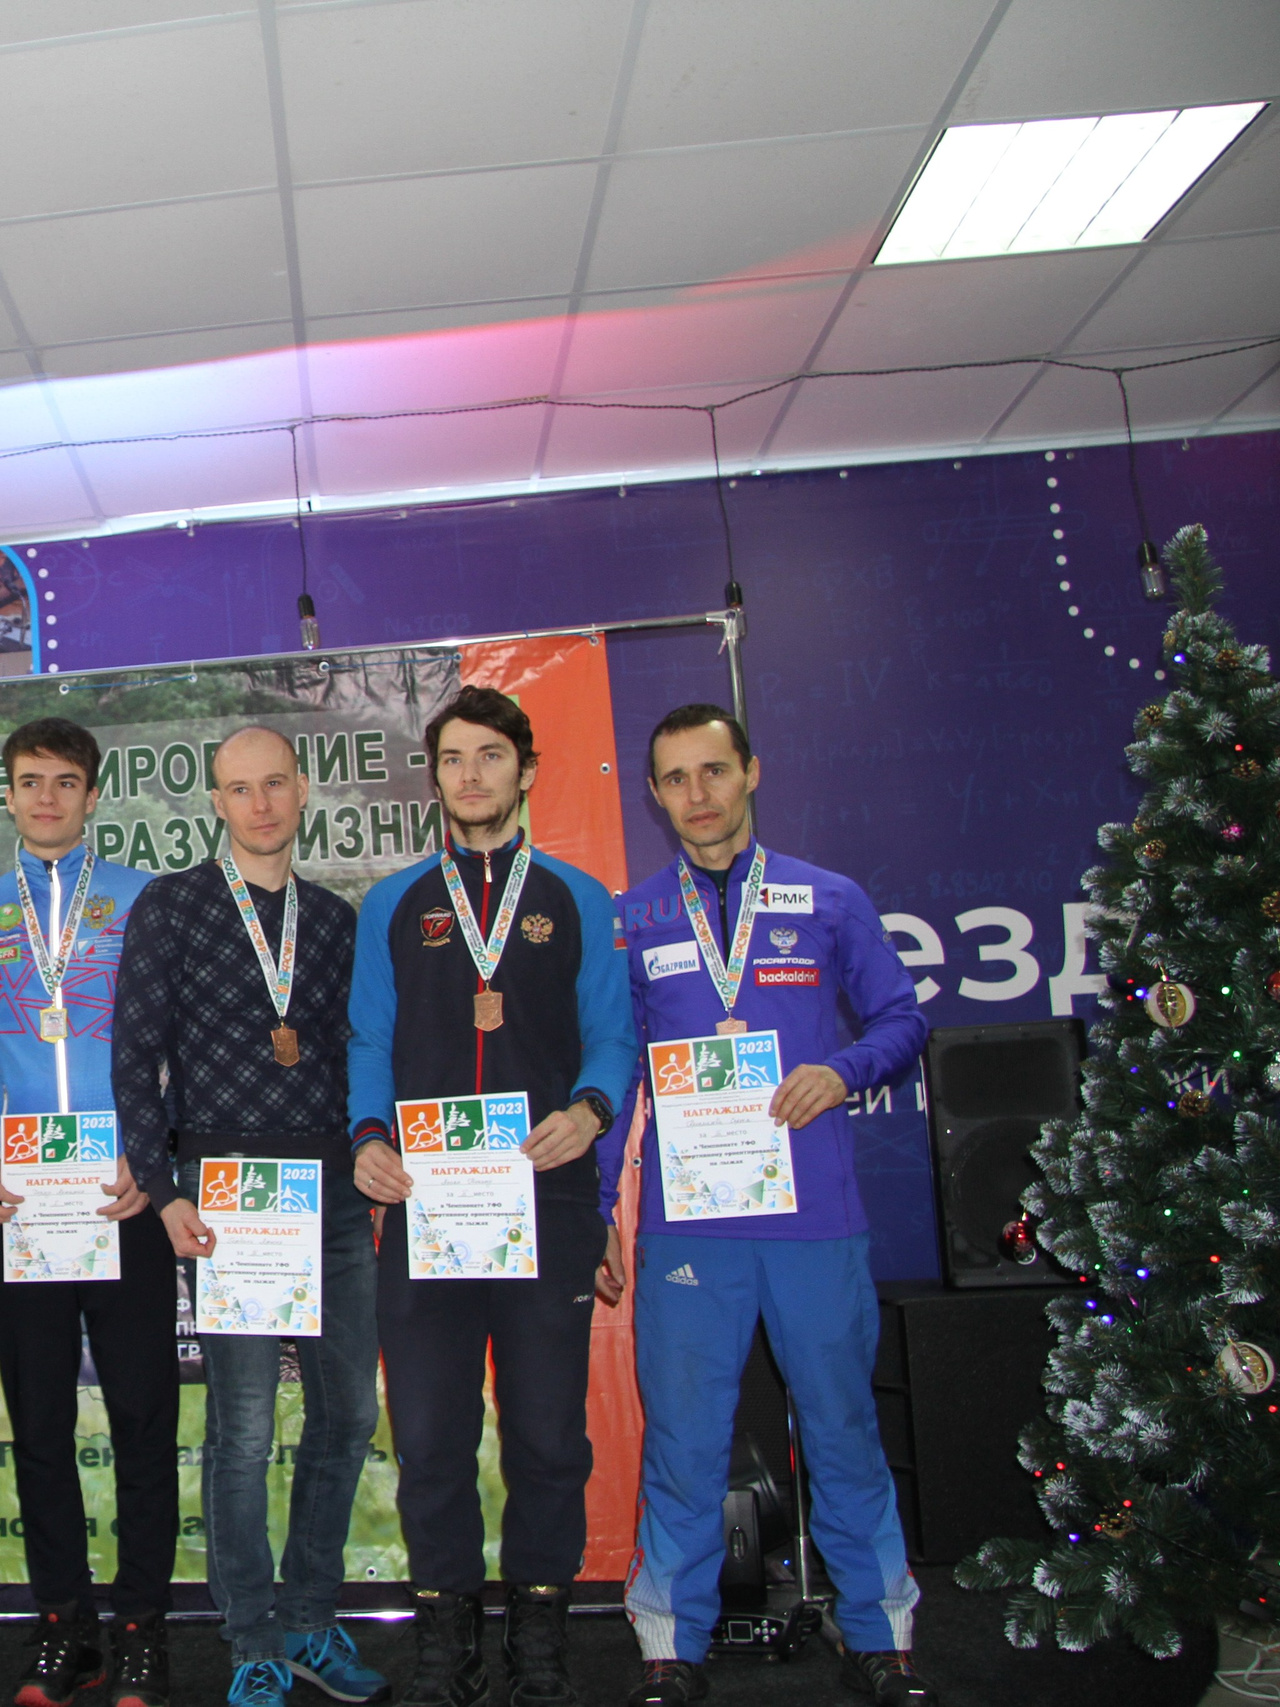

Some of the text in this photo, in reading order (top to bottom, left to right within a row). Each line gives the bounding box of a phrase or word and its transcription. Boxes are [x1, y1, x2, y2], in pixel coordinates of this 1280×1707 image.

[513, 855, 528, 879] 2023
[77, 869, 89, 896] 2023
[750, 863, 762, 890] 2023
[661, 960, 696, 973] GAZPROM
[758, 970, 815, 983] backaldrin
[738, 1040, 773, 1055] 2023
[488, 1103, 523, 1115] 2023
[683, 1103, 763, 1118] НАГРАЖДАЕТ
[82, 1117, 114, 1129] 2023
[283, 1168, 316, 1180] 2023
[431, 1166, 512, 1176] НАГРАЖДАЕТ
[26, 1177, 101, 1187] НАГРАЖДАЕТ
[223, 1227, 300, 1236] НАГРАЖДАЕТ
[665, 1274, 699, 1286] adidas
